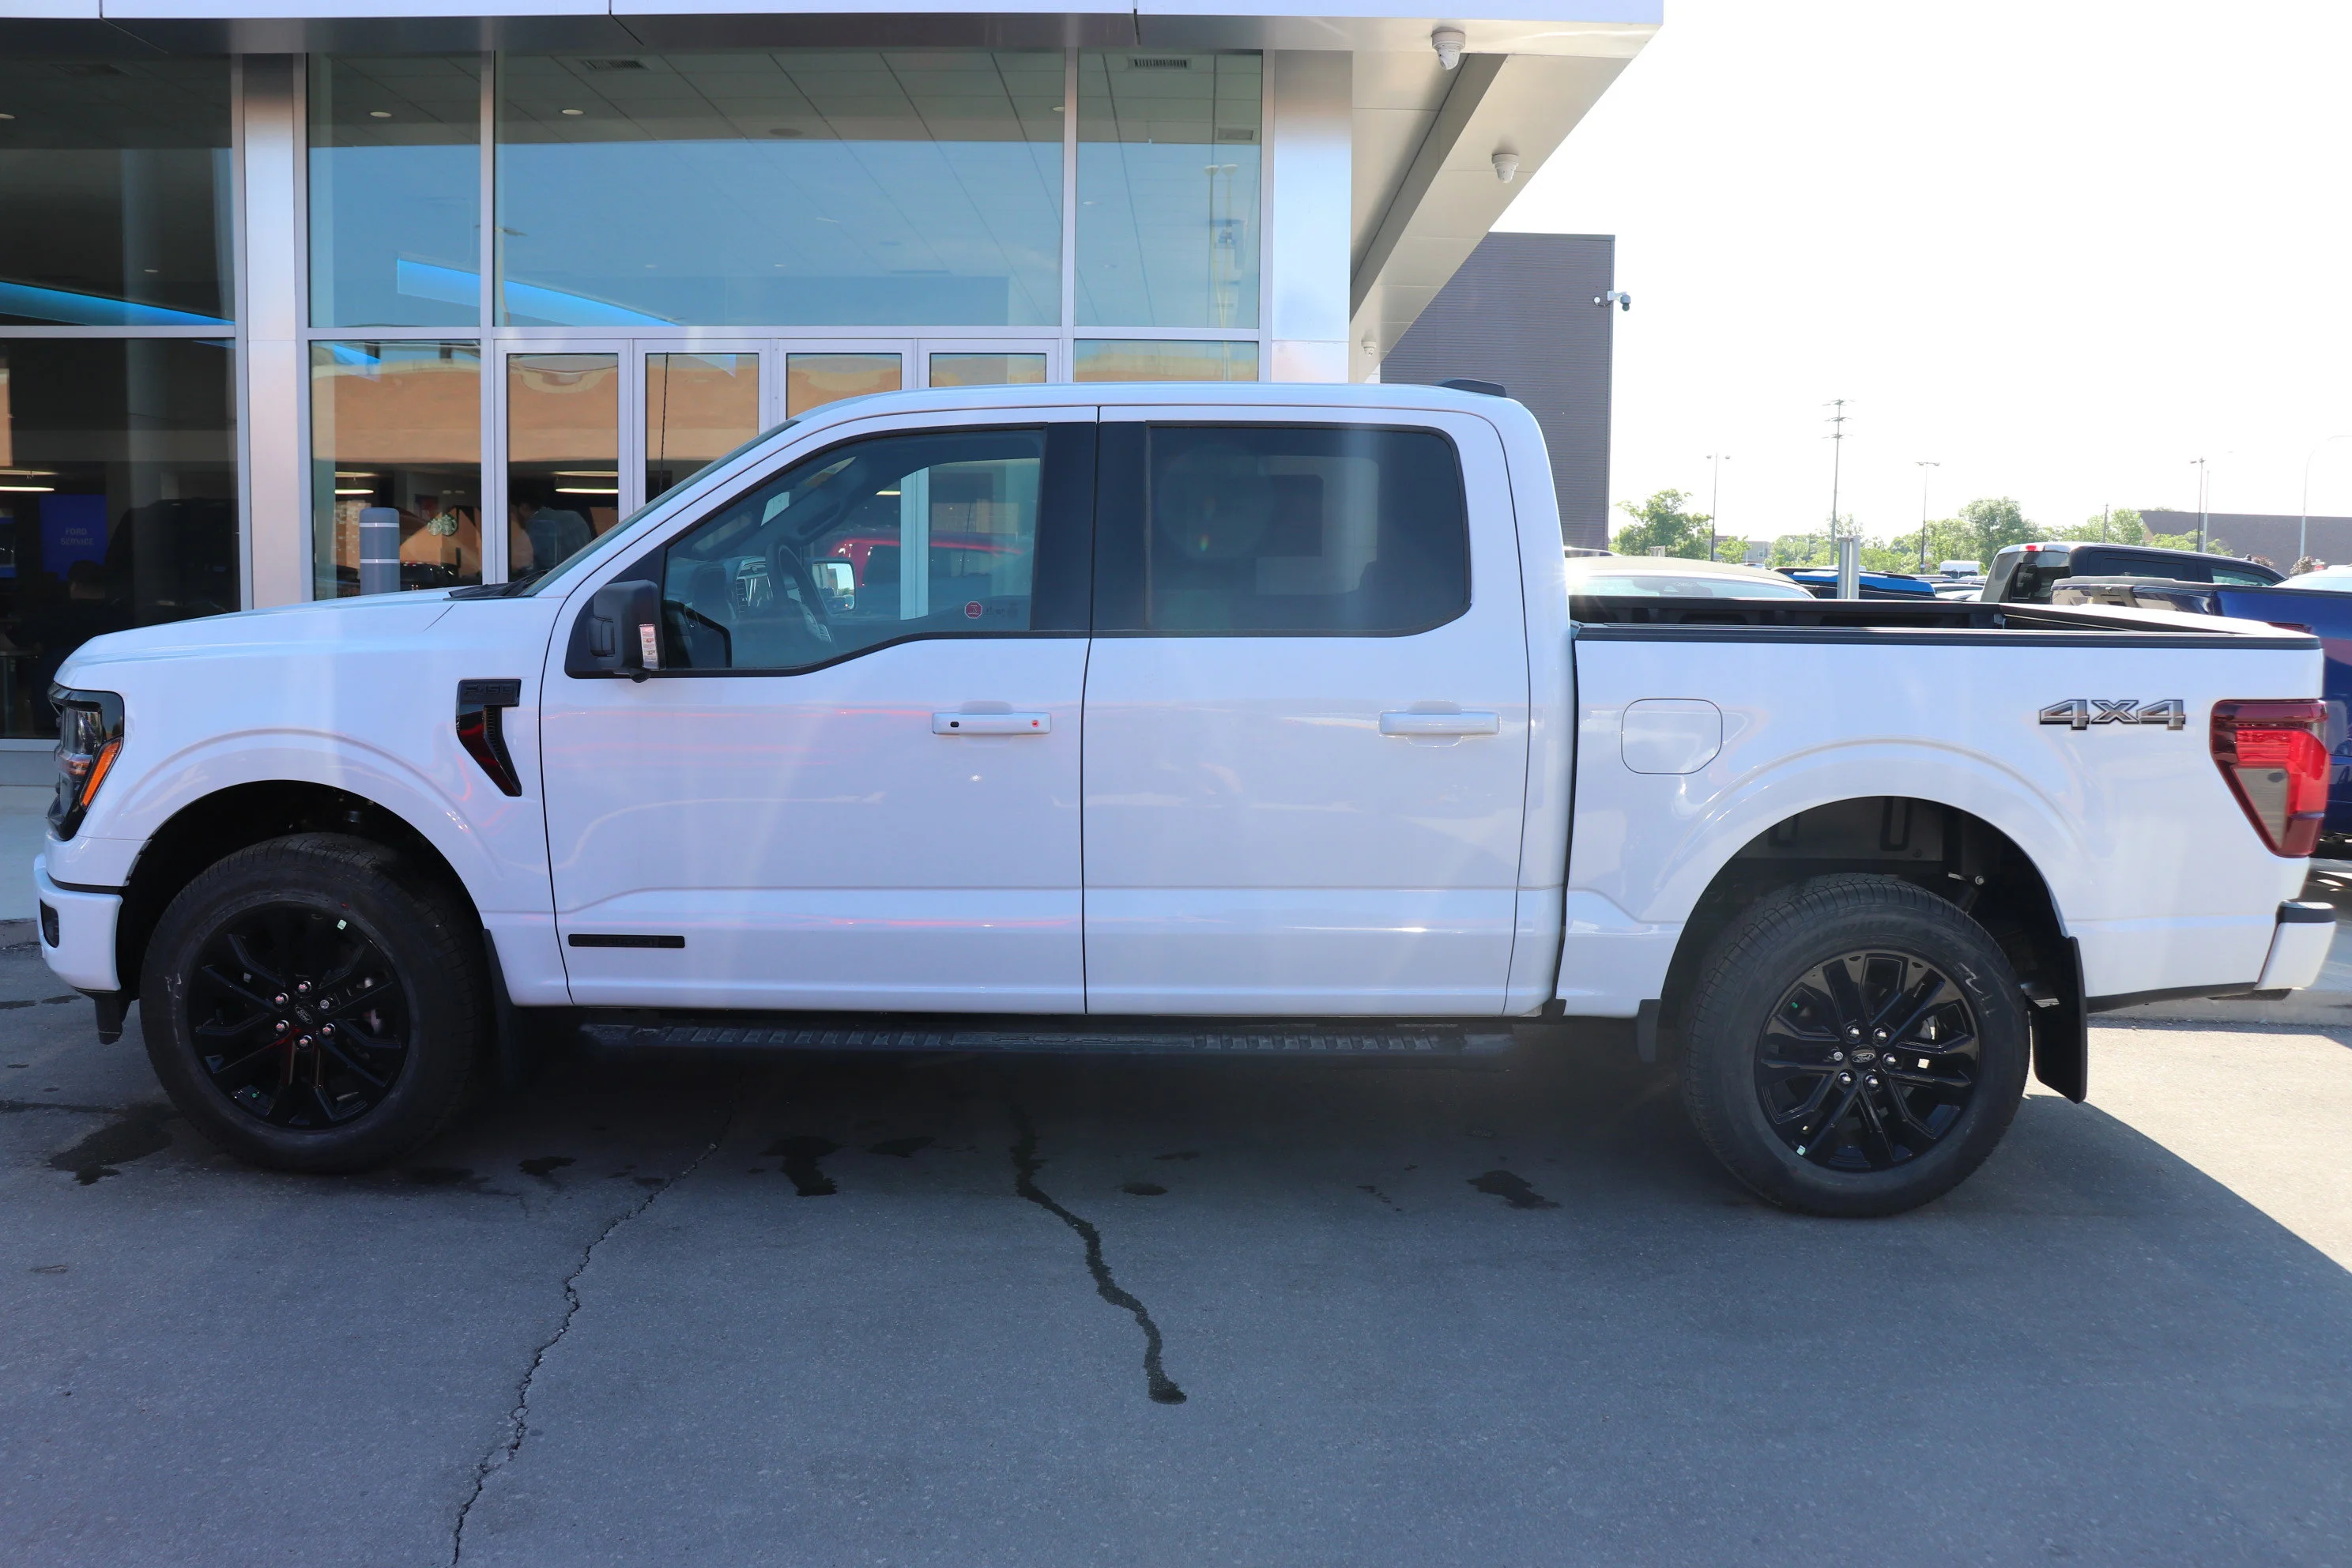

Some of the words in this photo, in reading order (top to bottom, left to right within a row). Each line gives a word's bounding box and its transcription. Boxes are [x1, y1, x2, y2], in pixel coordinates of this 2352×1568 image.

[65, 527, 88, 536] FORD
[464, 683, 515, 695] F-150
[1854, 1054, 1873, 1062] Ford
